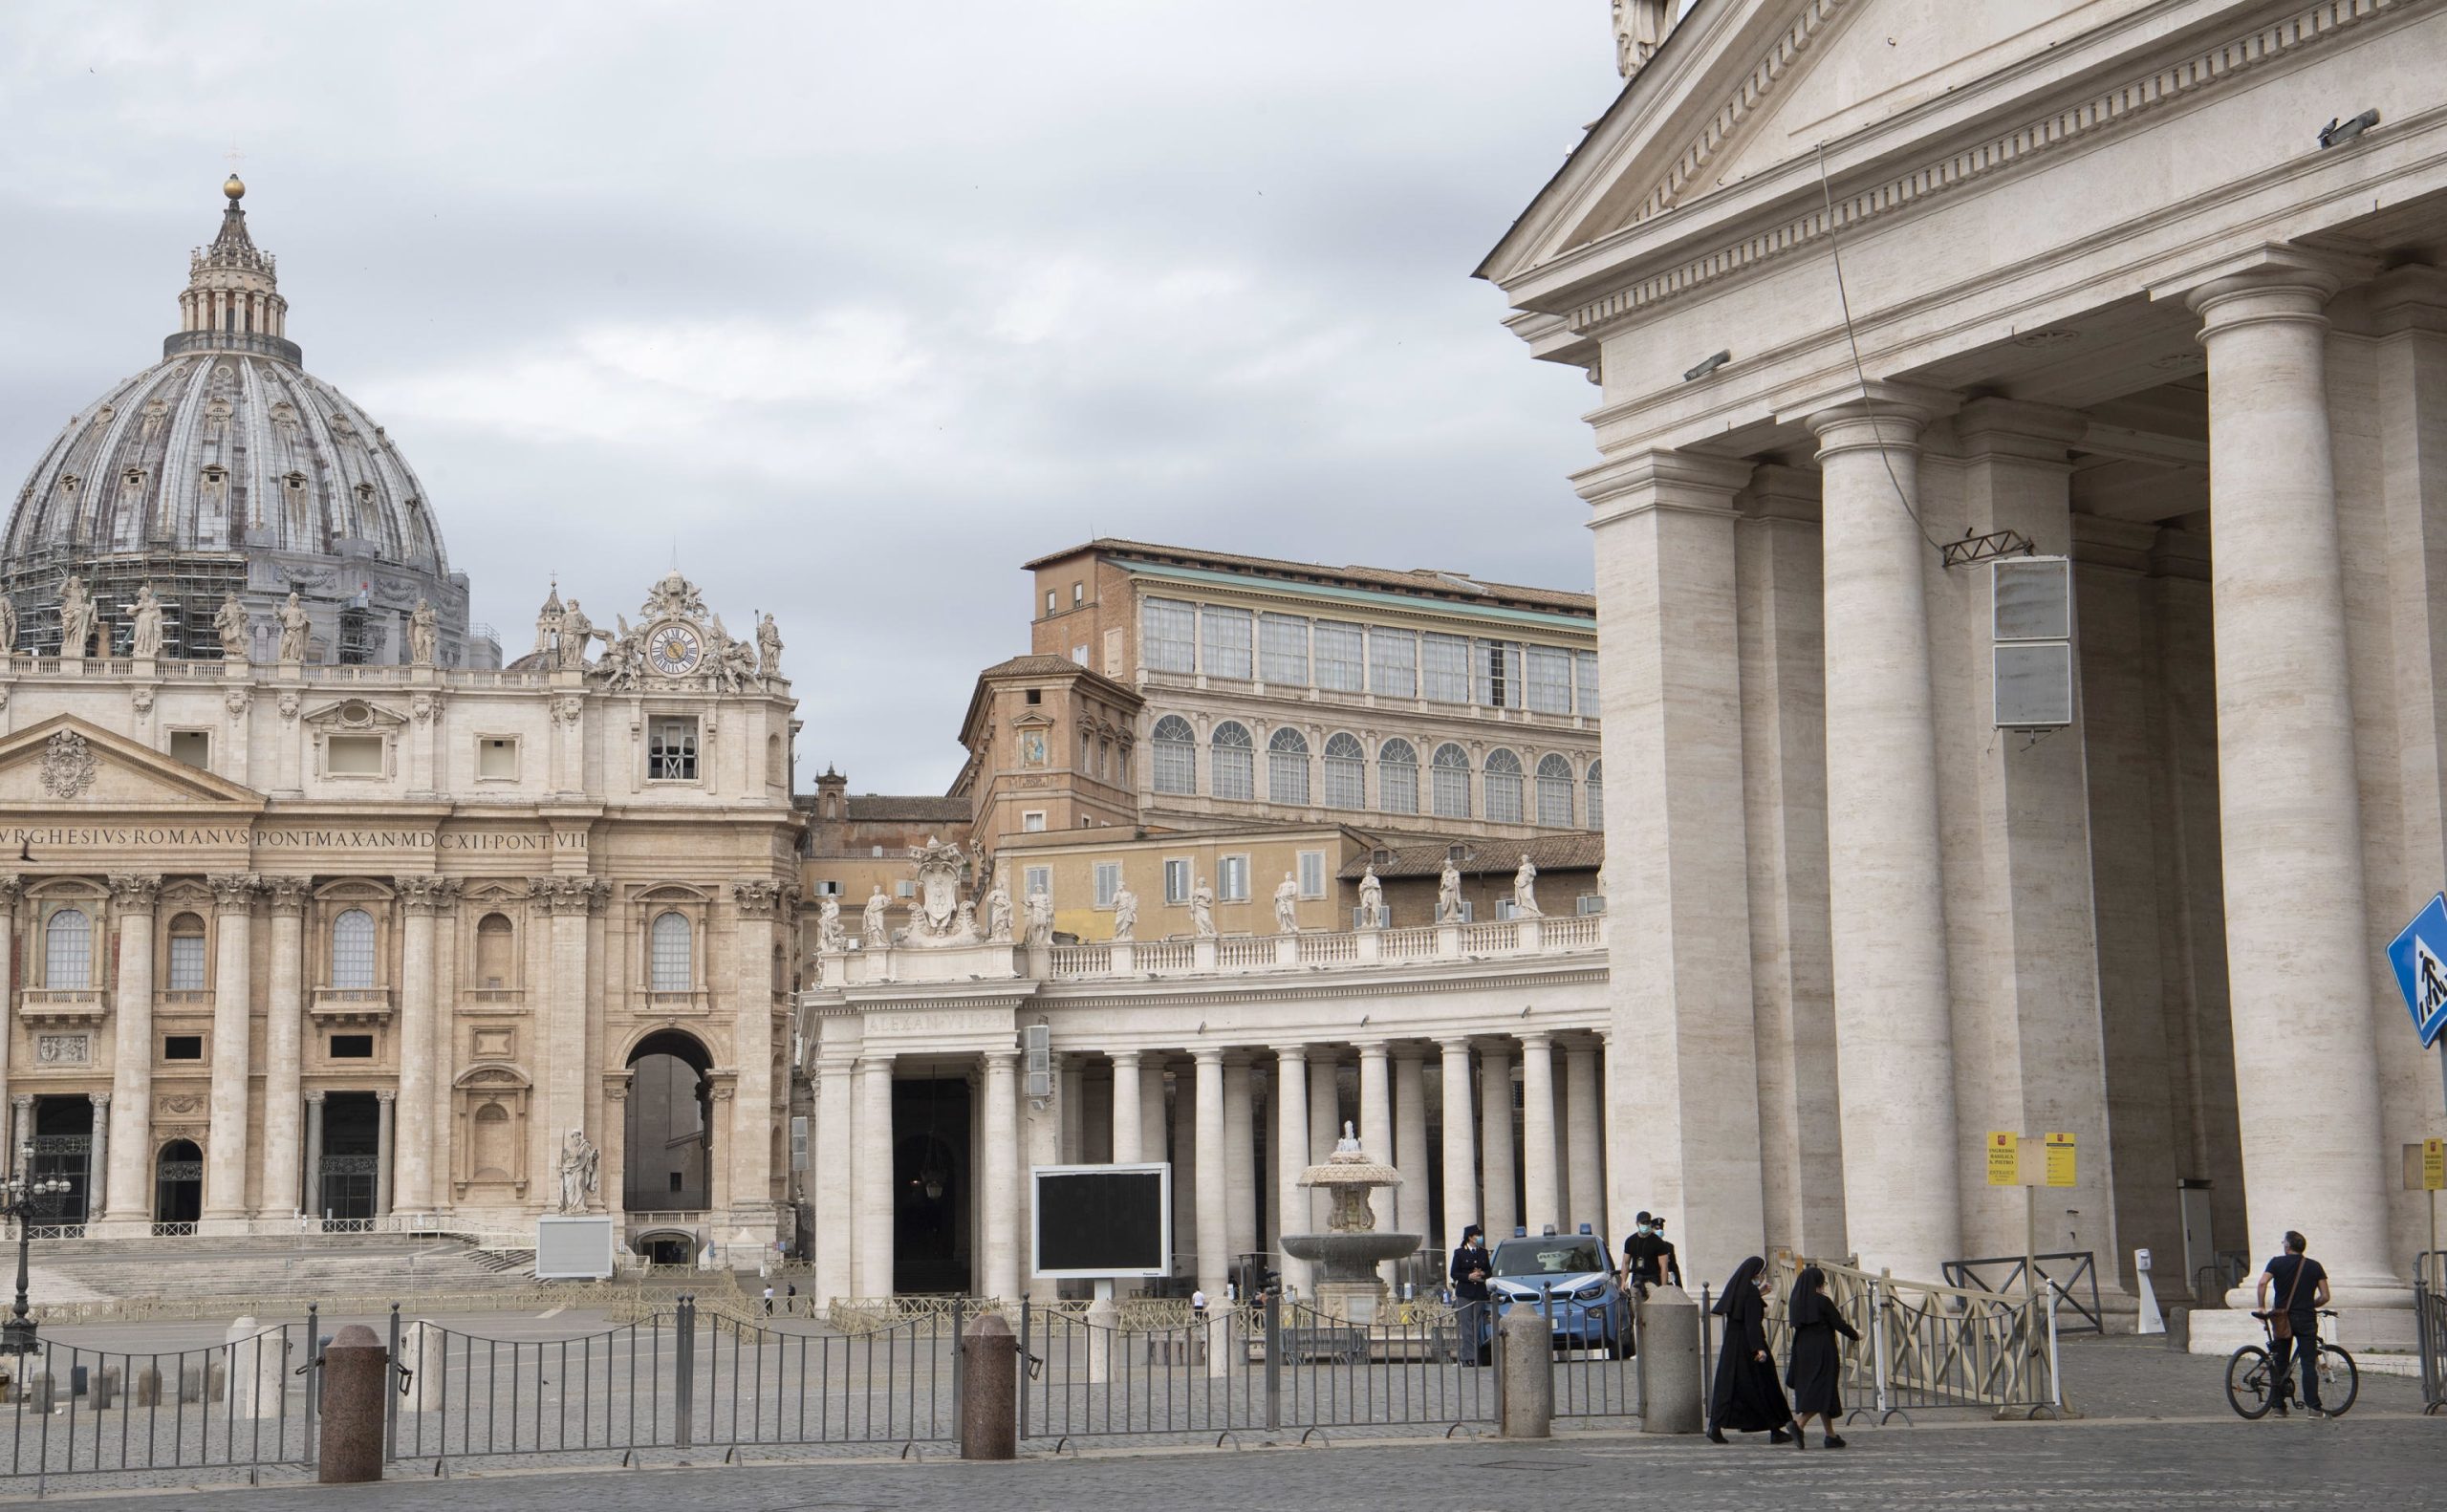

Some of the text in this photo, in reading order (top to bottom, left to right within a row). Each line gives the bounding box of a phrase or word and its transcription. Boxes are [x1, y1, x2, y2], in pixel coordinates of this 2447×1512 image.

[134, 829, 249, 845] ROMANVS
[495, 834, 551, 850] PONT
[557, 833, 587, 848] VII
